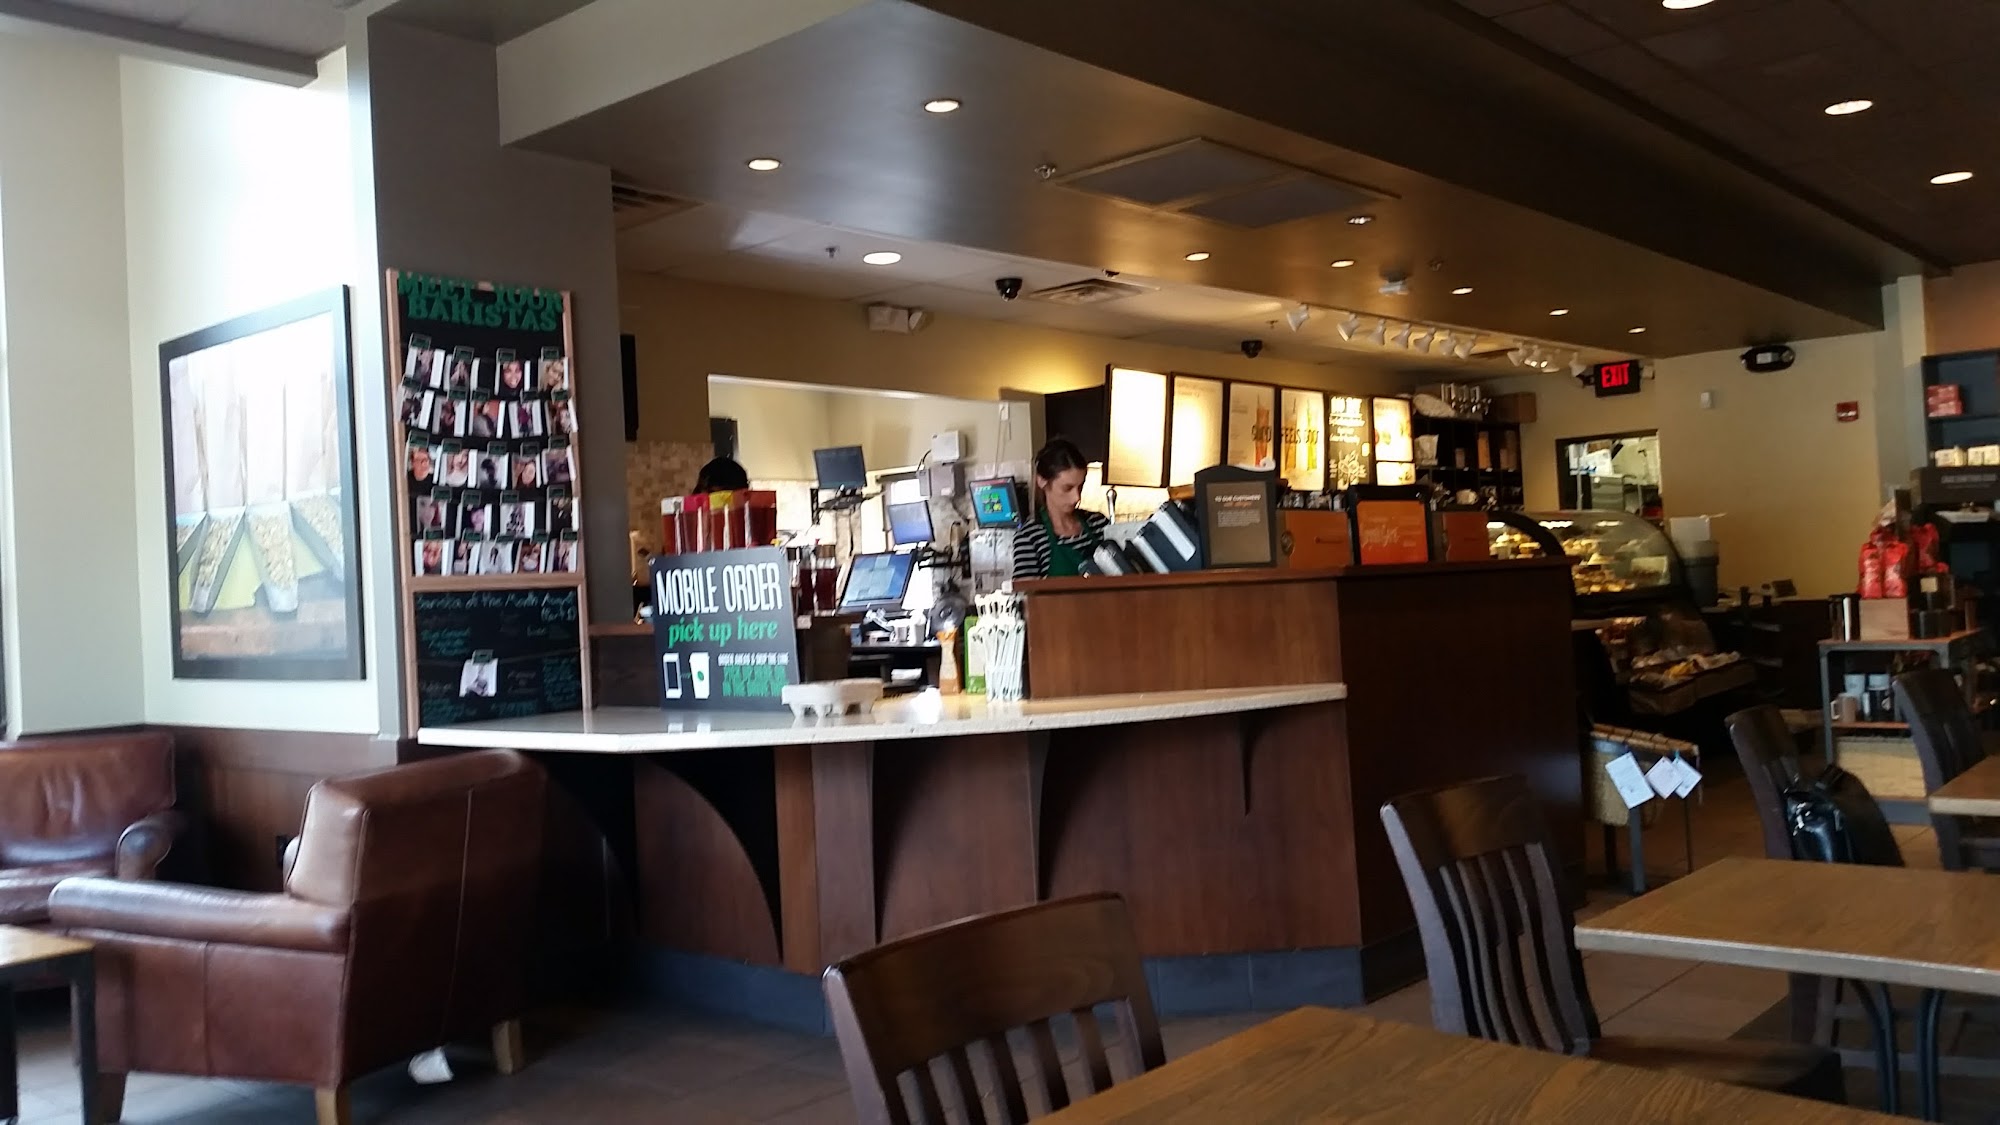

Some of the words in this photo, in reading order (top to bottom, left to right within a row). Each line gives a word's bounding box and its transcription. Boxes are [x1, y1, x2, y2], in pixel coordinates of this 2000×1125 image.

[397, 271, 475, 300] MEET
[494, 283, 564, 313] YOUR
[408, 295, 558, 331] BARISTAS
[1601, 362, 1630, 388] EXIT
[656, 566, 719, 616] MOBILE
[722, 562, 783, 613] ORDER
[668, 615, 705, 649] pick
[709, 621, 732, 648] up
[736, 614, 778, 641] here
